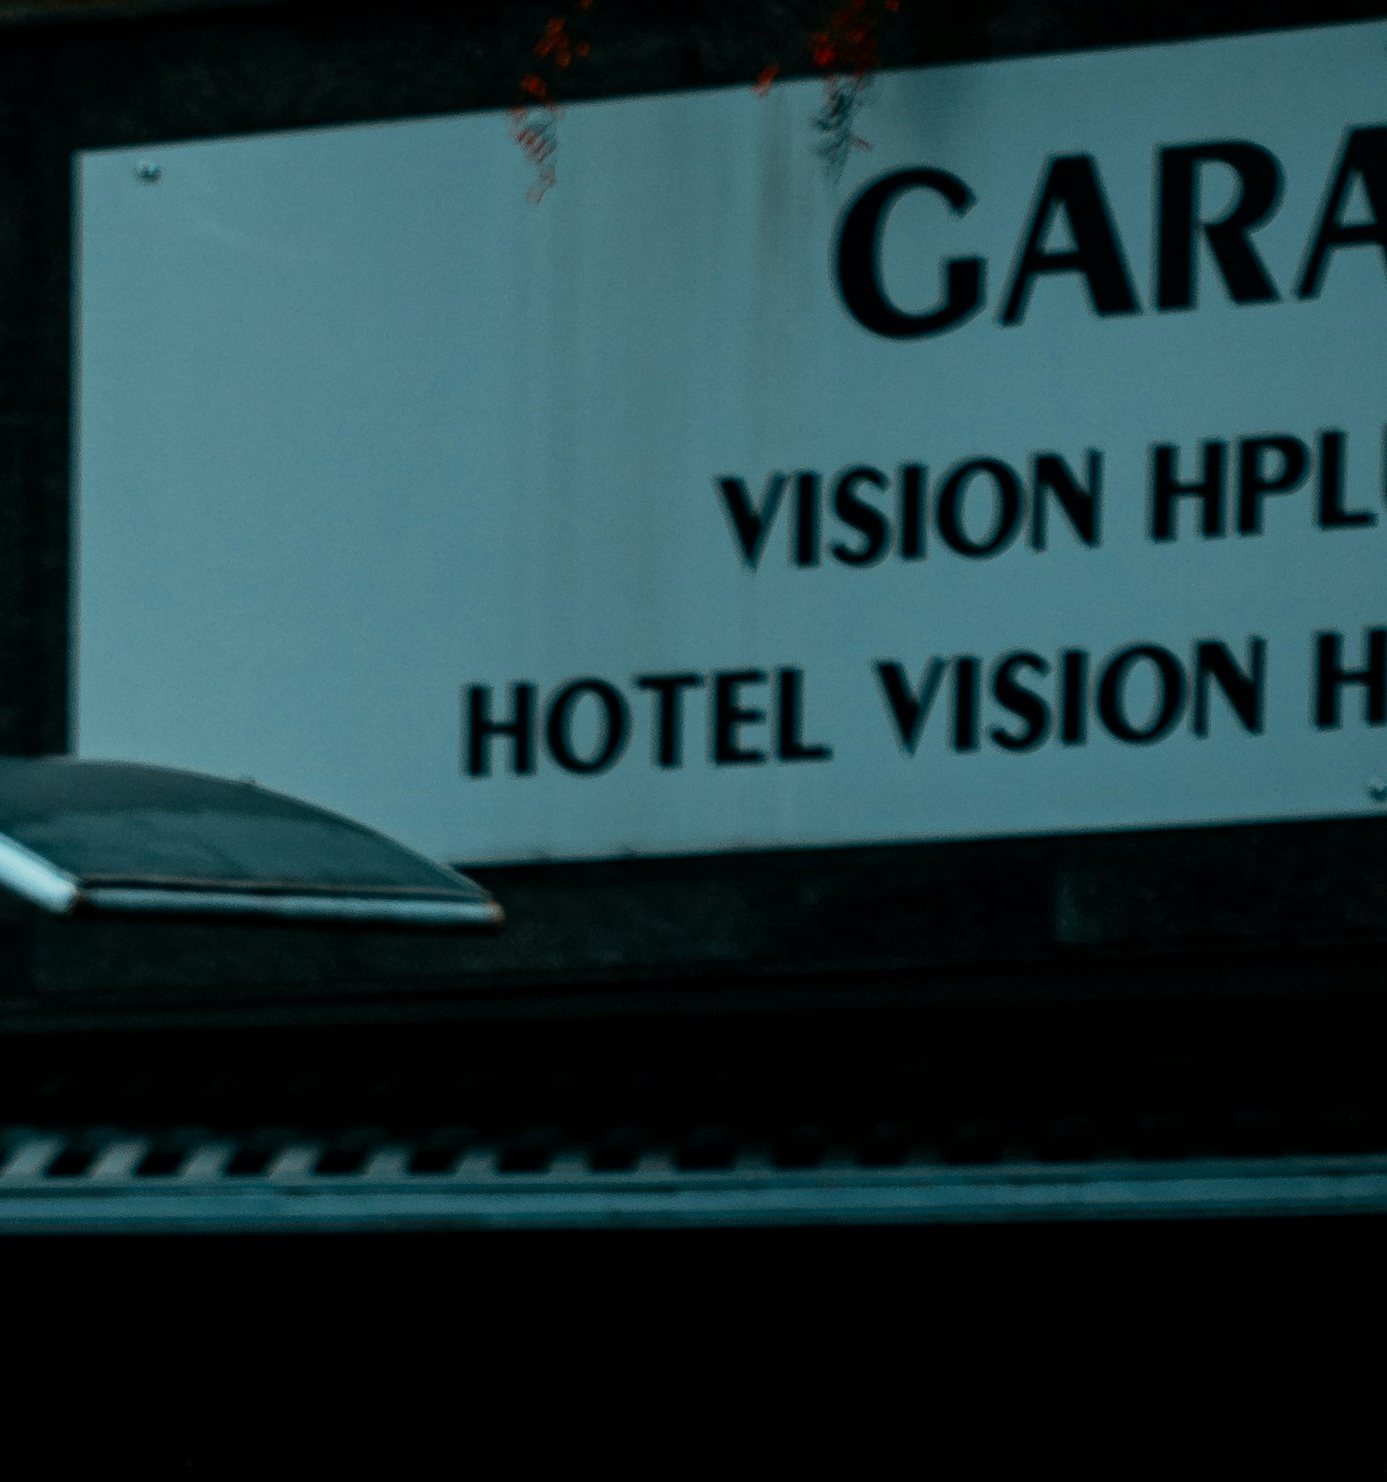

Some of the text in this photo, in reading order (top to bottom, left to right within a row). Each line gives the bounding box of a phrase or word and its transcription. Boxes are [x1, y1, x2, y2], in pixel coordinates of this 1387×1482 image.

[716, 422, 1387, 574] VISION HPL
[462, 665, 834, 781] HOTEL
[873, 634, 1268, 758] VISION
